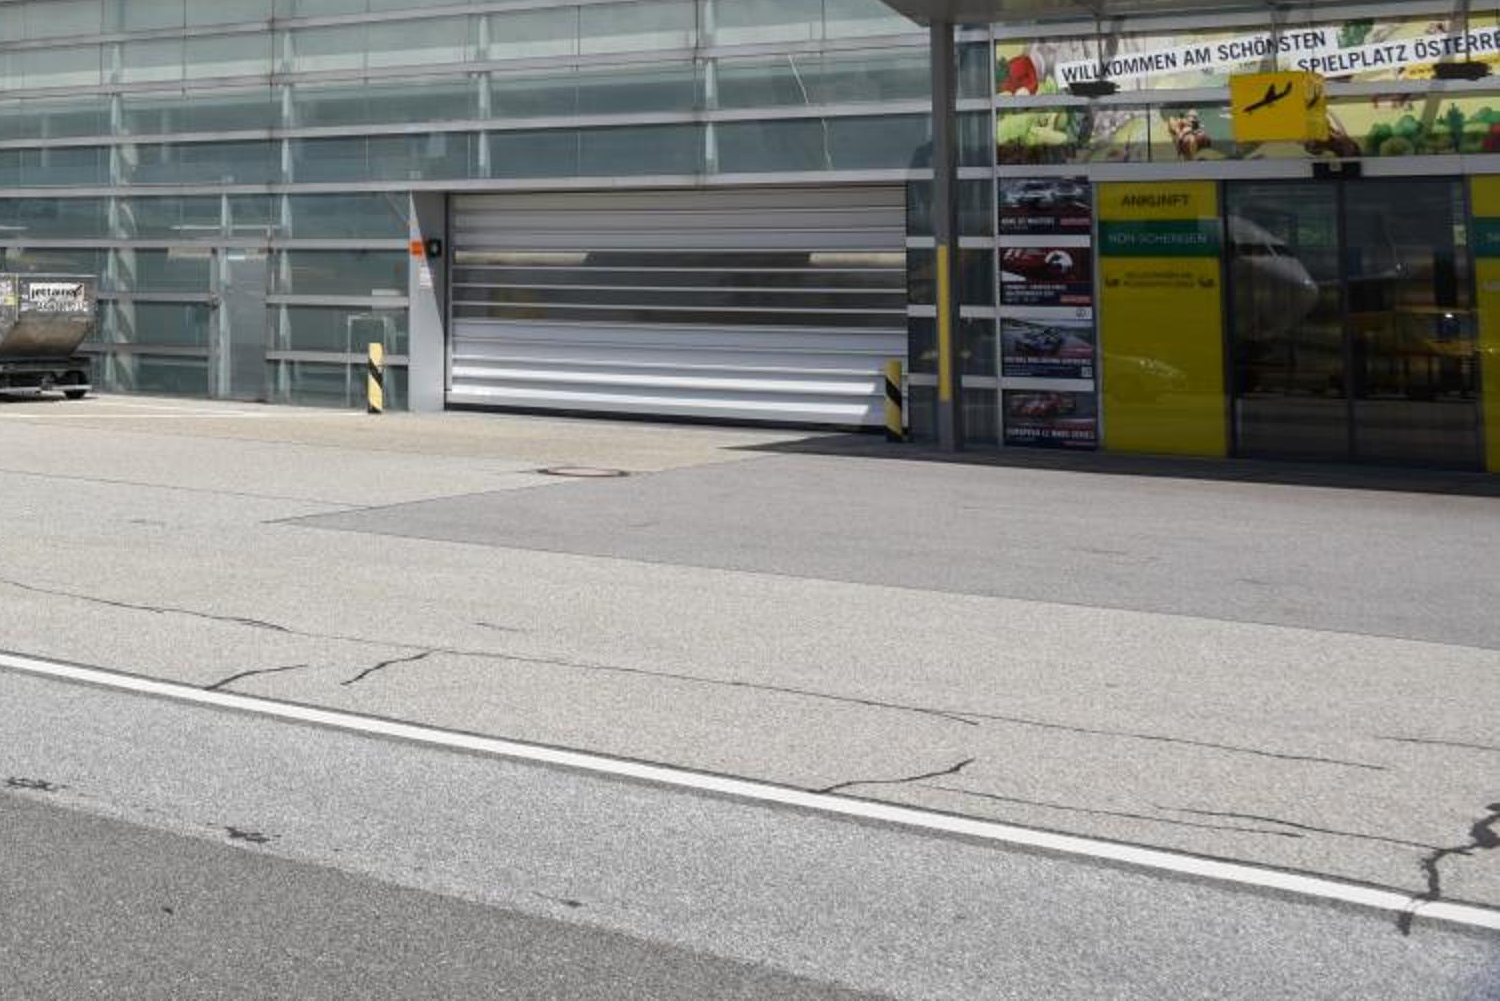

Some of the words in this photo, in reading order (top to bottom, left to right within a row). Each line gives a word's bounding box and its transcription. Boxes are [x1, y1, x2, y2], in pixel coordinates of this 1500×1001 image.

[1061, 52, 1177, 82] WILLKOMMEN
[1183, 47, 1211, 66] AM
[1218, 31, 1326, 61] SCHÖNSTEN
[1297, 45, 1408, 72] SPIELPLATZ
[1121, 194, 1189, 207] ANKUNFT
